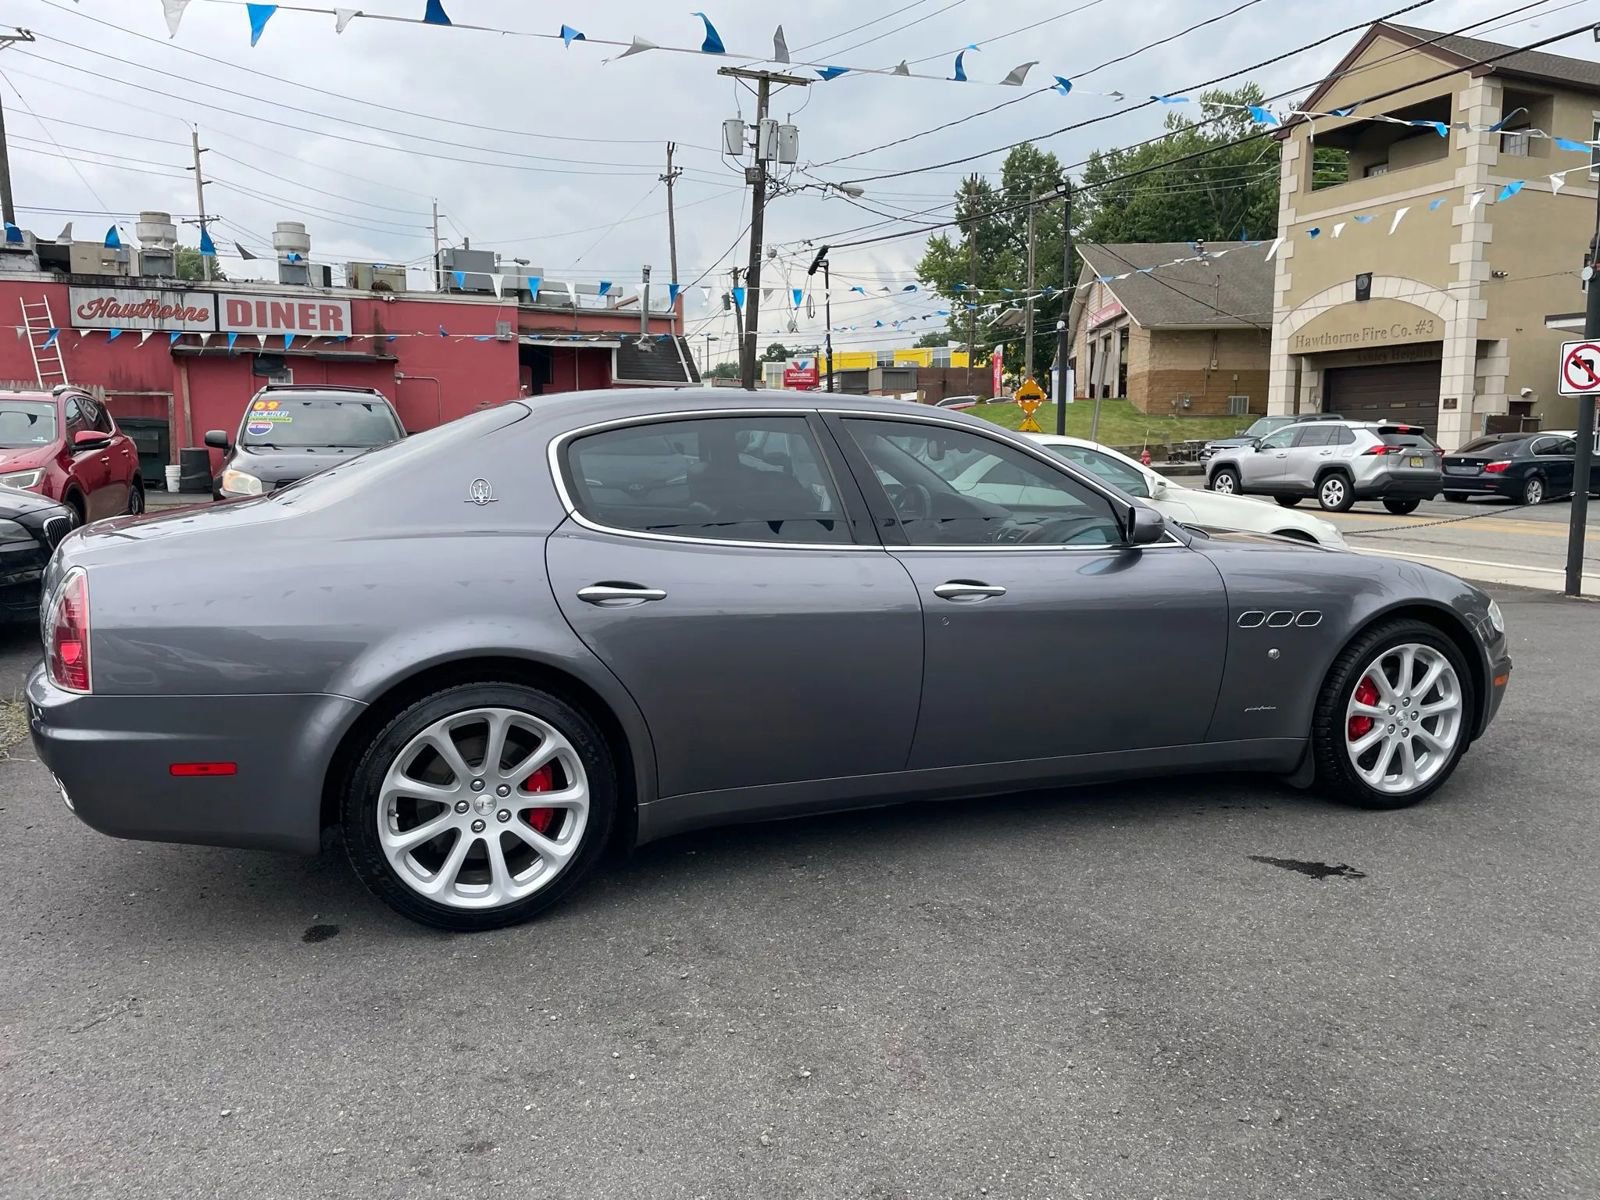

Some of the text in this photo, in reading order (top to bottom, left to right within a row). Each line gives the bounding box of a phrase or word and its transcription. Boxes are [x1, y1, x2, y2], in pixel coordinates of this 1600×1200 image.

[77, 296, 344, 331] Hawthorne DINER
[1295, 319, 1435, 348] Hawthorne Fire Co. #3
[254, 401, 279, 410] 09
